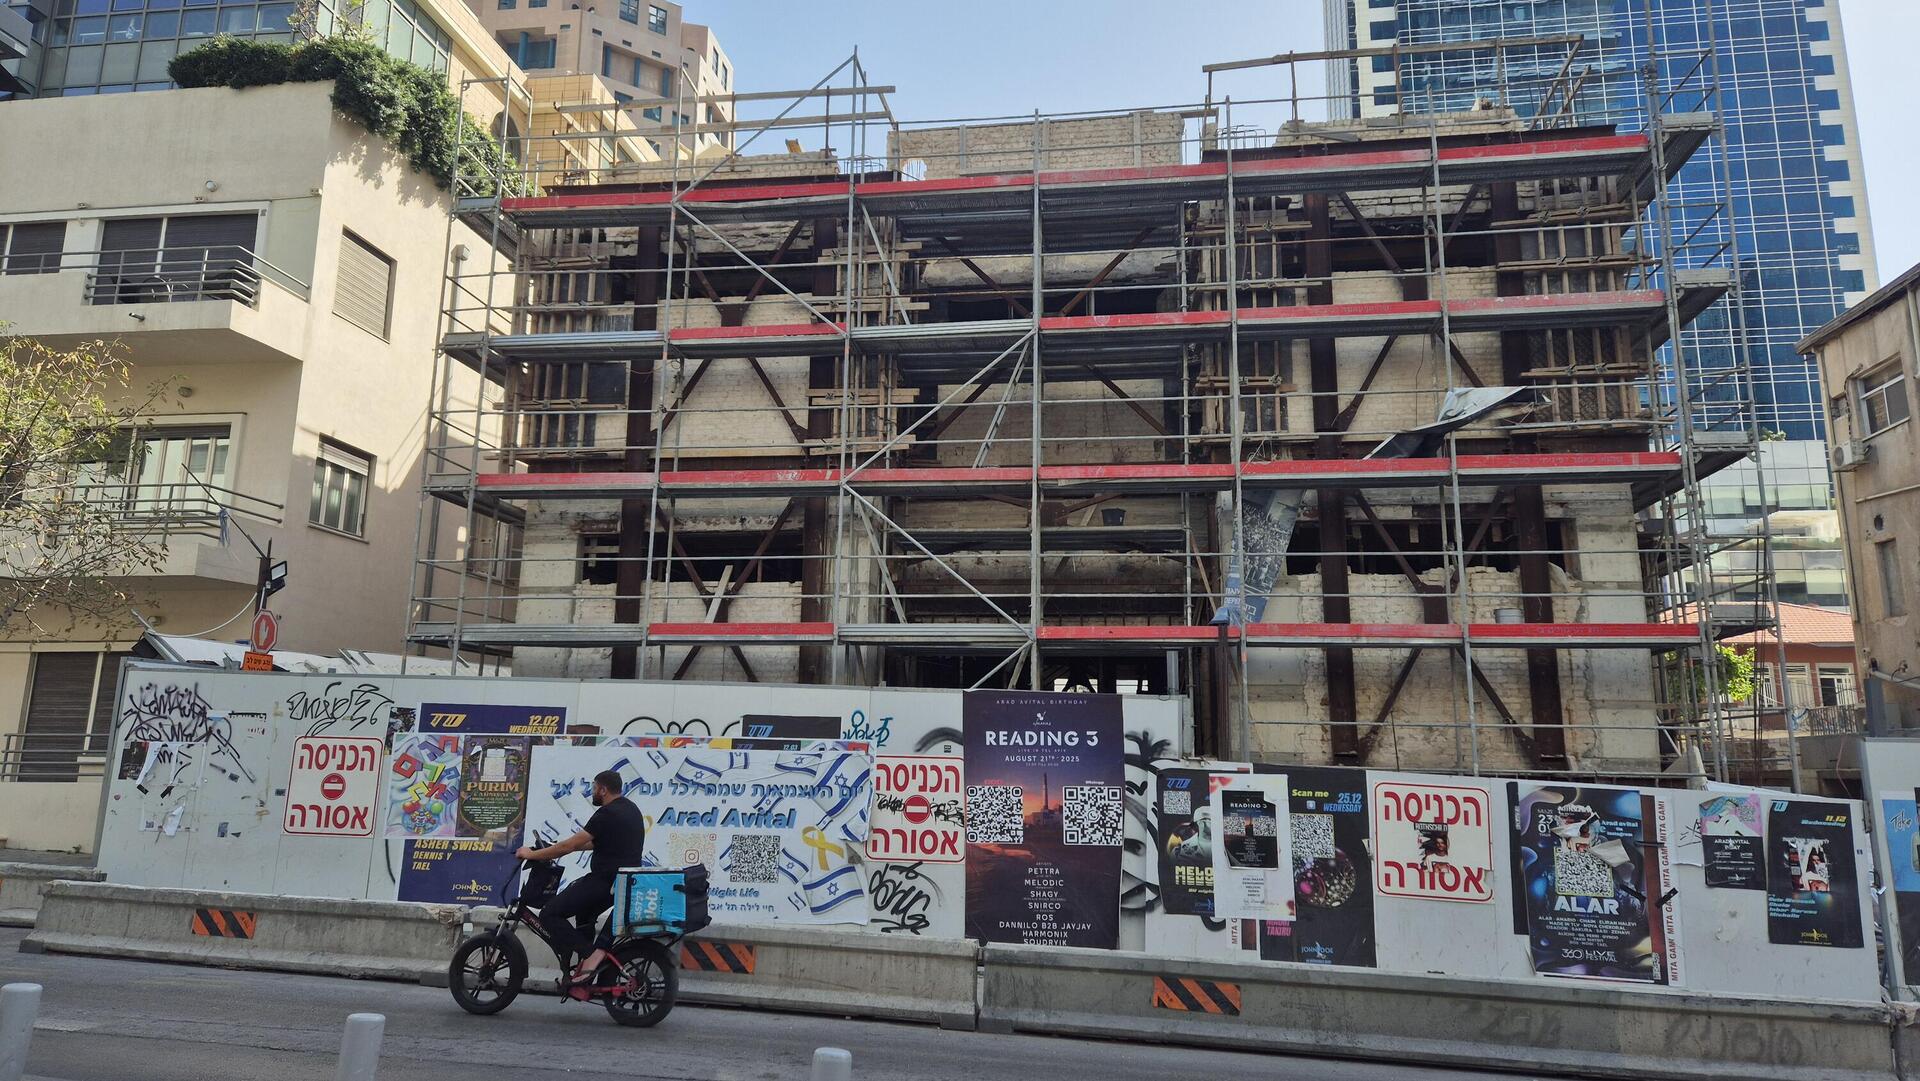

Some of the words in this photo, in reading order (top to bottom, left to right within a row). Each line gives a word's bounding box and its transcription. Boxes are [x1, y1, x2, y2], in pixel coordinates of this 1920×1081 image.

[528, 715, 560, 726] 12.02
[509, 725, 558, 734] WEDNESDAY
[985, 730, 1080, 746] READING
[1086, 731, 1099, 746] 3
[299, 744, 375, 771] הכניסה
[876, 764, 960, 793] הכניסה
[466, 782, 520, 792] PURIM
[639, 782, 663, 796] עם
[669, 778, 698, 796] לכל
[751, 783, 833, 799] העצמאות
[839, 784, 864, 799] יום
[1292, 788, 1313, 797] Scan
[1338, 793, 1362, 804] 25.12
[1324, 803, 1362, 812] WEDNESDAY
[1384, 791, 1482, 826] הכניסה
[1658, 800, 1666, 824] GAMI
[289, 804, 368, 829] אסורה
[657, 806, 720, 828] Arad
[720, 806, 798, 828] Avital
[1538, 814, 1553, 824] 23
[414, 839, 449, 850] ASHER
[452, 840, 494, 852] SWISSA
[872, 828, 959, 855] אסורה
[412, 851, 444, 860] DENNIS
[446, 852, 452, 860] Y
[412, 862, 431, 871] TAEL
[1175, 866, 1214, 886] MELO
[1384, 861, 1485, 894] אסורה
[1664, 868, 1672, 888] MITA
[476, 884, 492, 892] DOE
[739, 887, 760, 898] Life
[1030, 890, 1059, 898] SHAGY
[708, 903, 723, 911] אבי
[725, 902, 738, 911] תל
[740, 902, 760, 912] לילה
[762, 904, 774, 912] חיי
[1028, 902, 1062, 910] SNIRCO
[1554, 896, 1620, 916] ALAR
[999, 921, 1038, 929] DANNILO
[1042, 922, 1058, 930] B2B
[1061, 922, 1092, 930] JAYJAY
[1667, 914, 1675, 934] MITA
[1022, 930, 1068, 938] HARMONIX
[1562, 948, 1585, 960] 360
